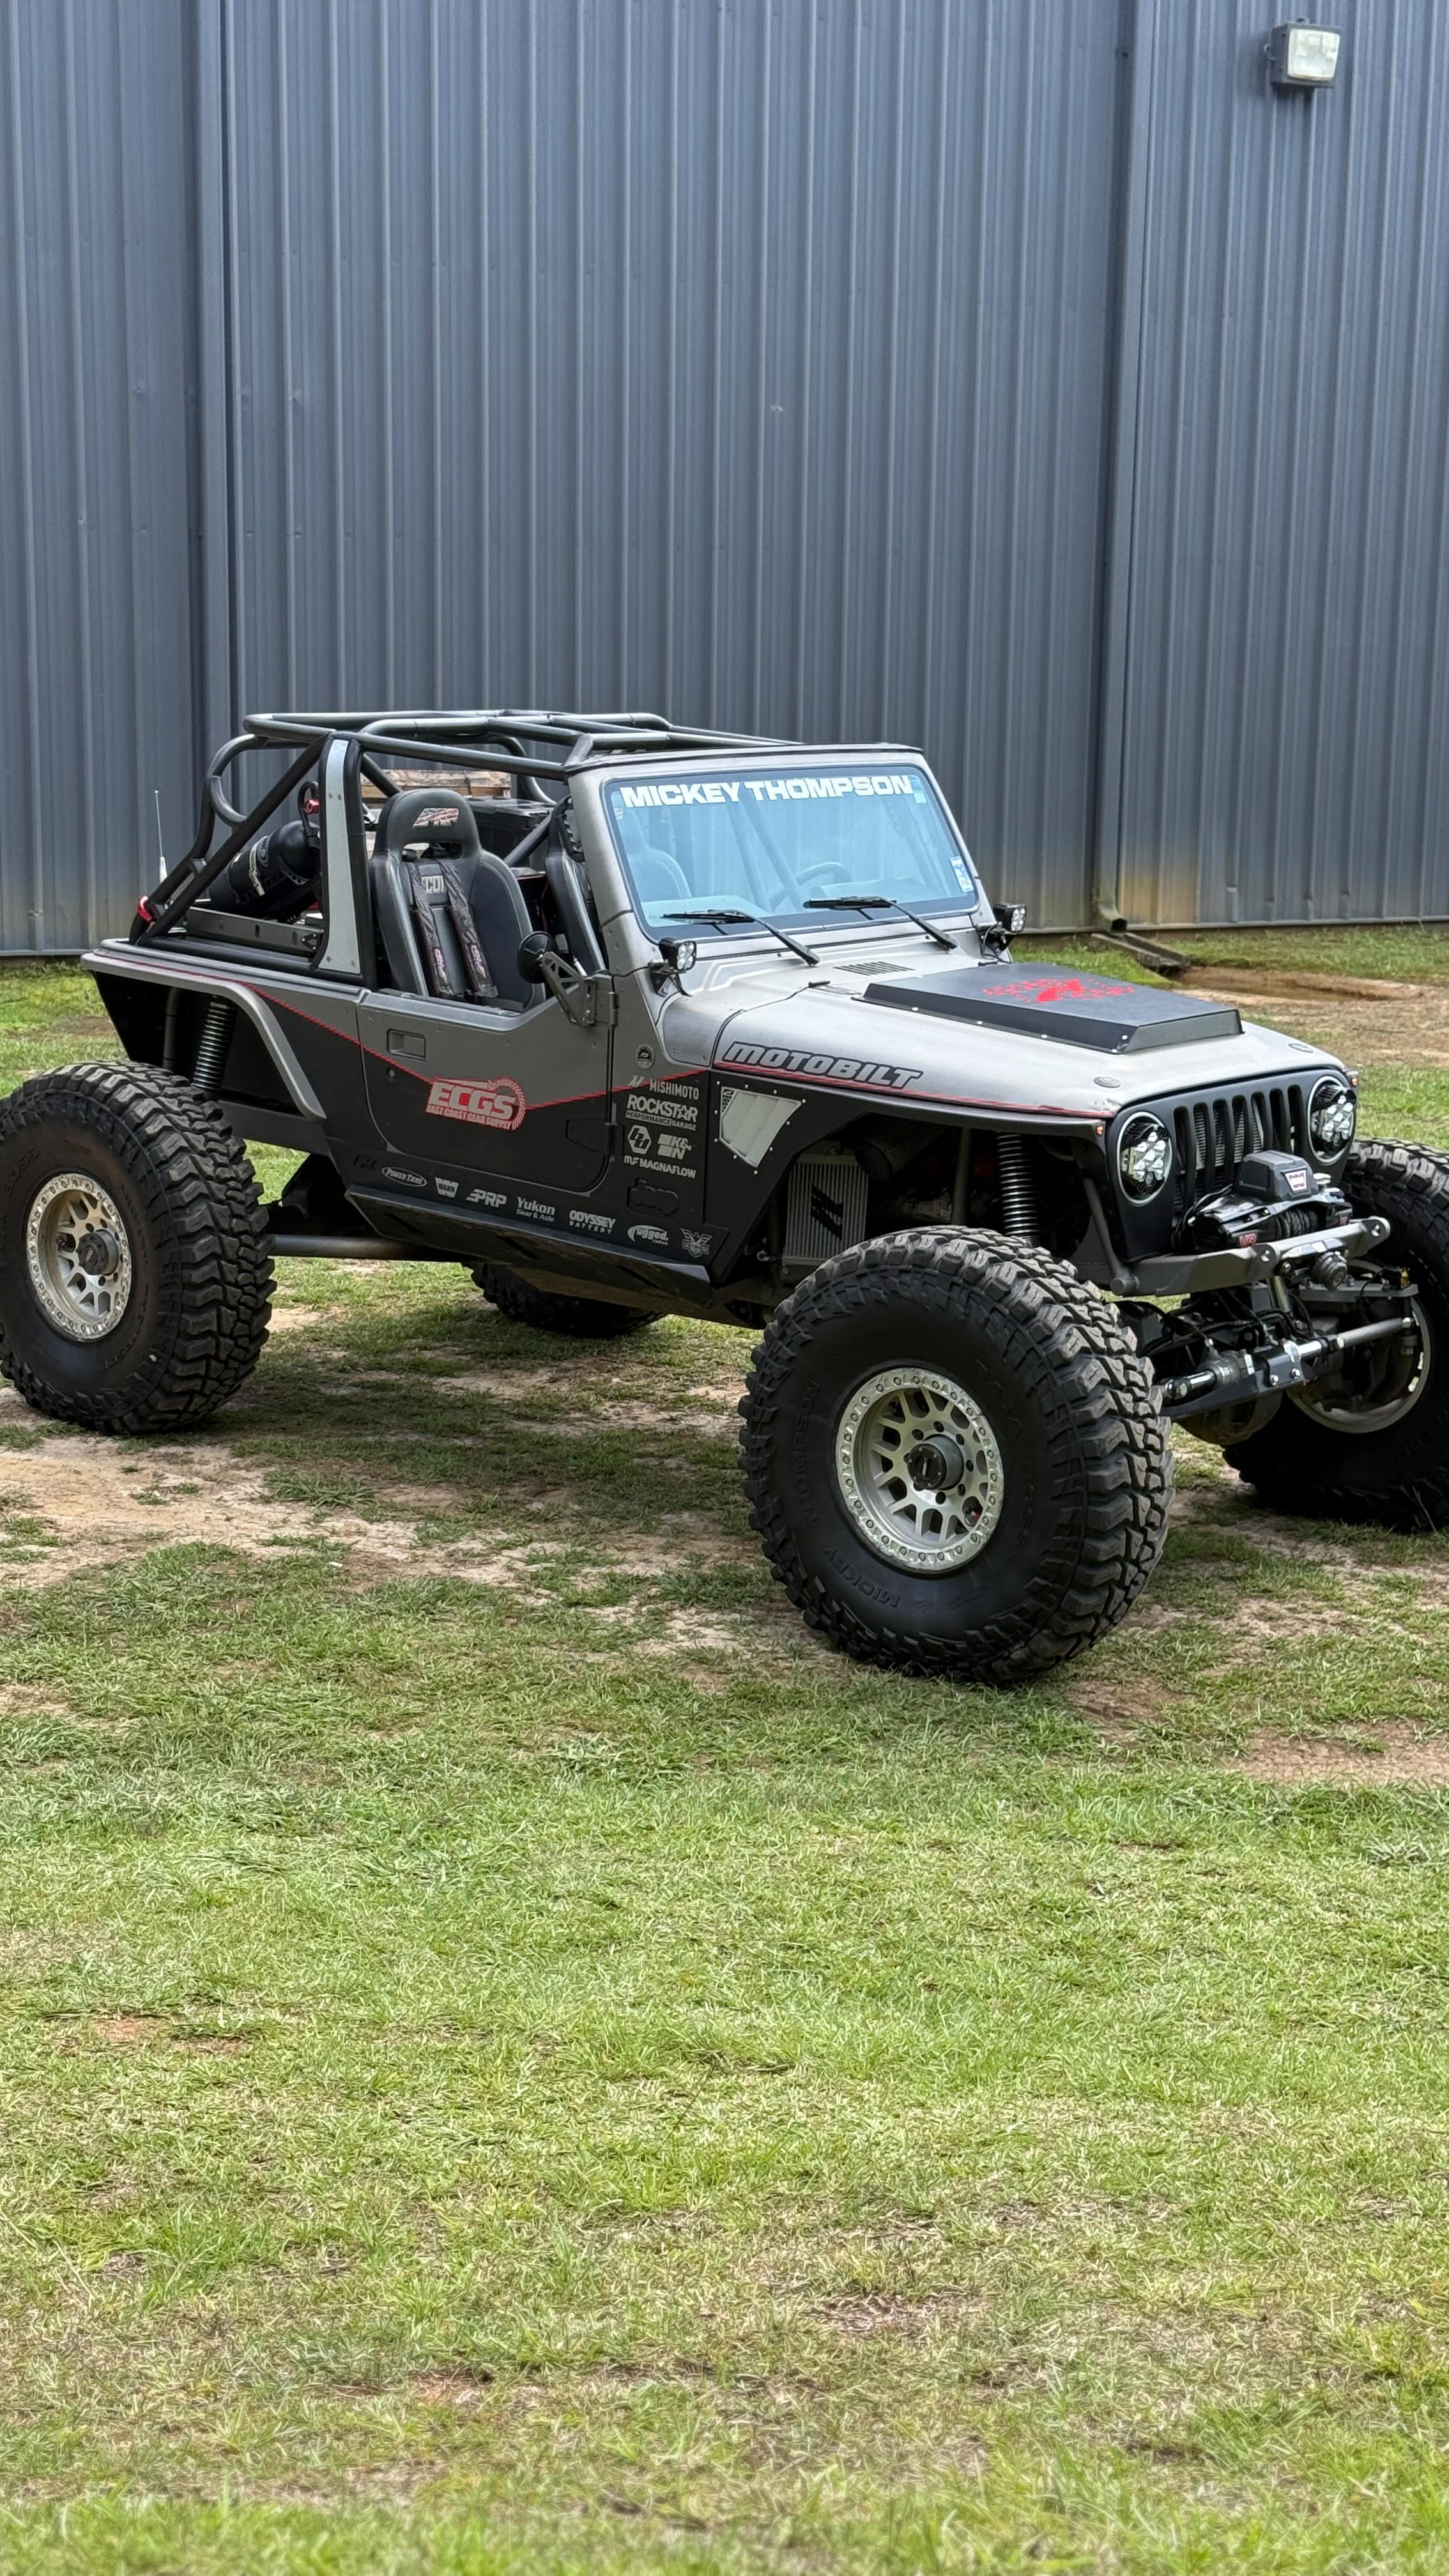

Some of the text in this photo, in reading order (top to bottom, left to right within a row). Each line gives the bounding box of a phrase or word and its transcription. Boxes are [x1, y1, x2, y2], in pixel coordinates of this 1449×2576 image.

[619, 775, 914, 808] MICKEY THOMPSON
[721, 1041, 924, 1089] MOTOBILT
[427, 1081, 517, 1120] ECGS
[649, 1078, 700, 1101] MISHIMOTO
[426, 1104, 512, 1130] EAST COAST GEAR SUPPLY
[626, 1094, 698, 1123] ROCKSTAR
[626, 1110, 698, 1131] PERFORMANCE GARAGE
[639, 1158, 696, 1179] MAGNAFLOW
[465, 1188, 507, 1208] PRP
[516, 1197, 555, 1216] Yukon
[569, 1209, 617, 1229] ODYSSEY
[569, 1220, 612, 1235] BATTERY
